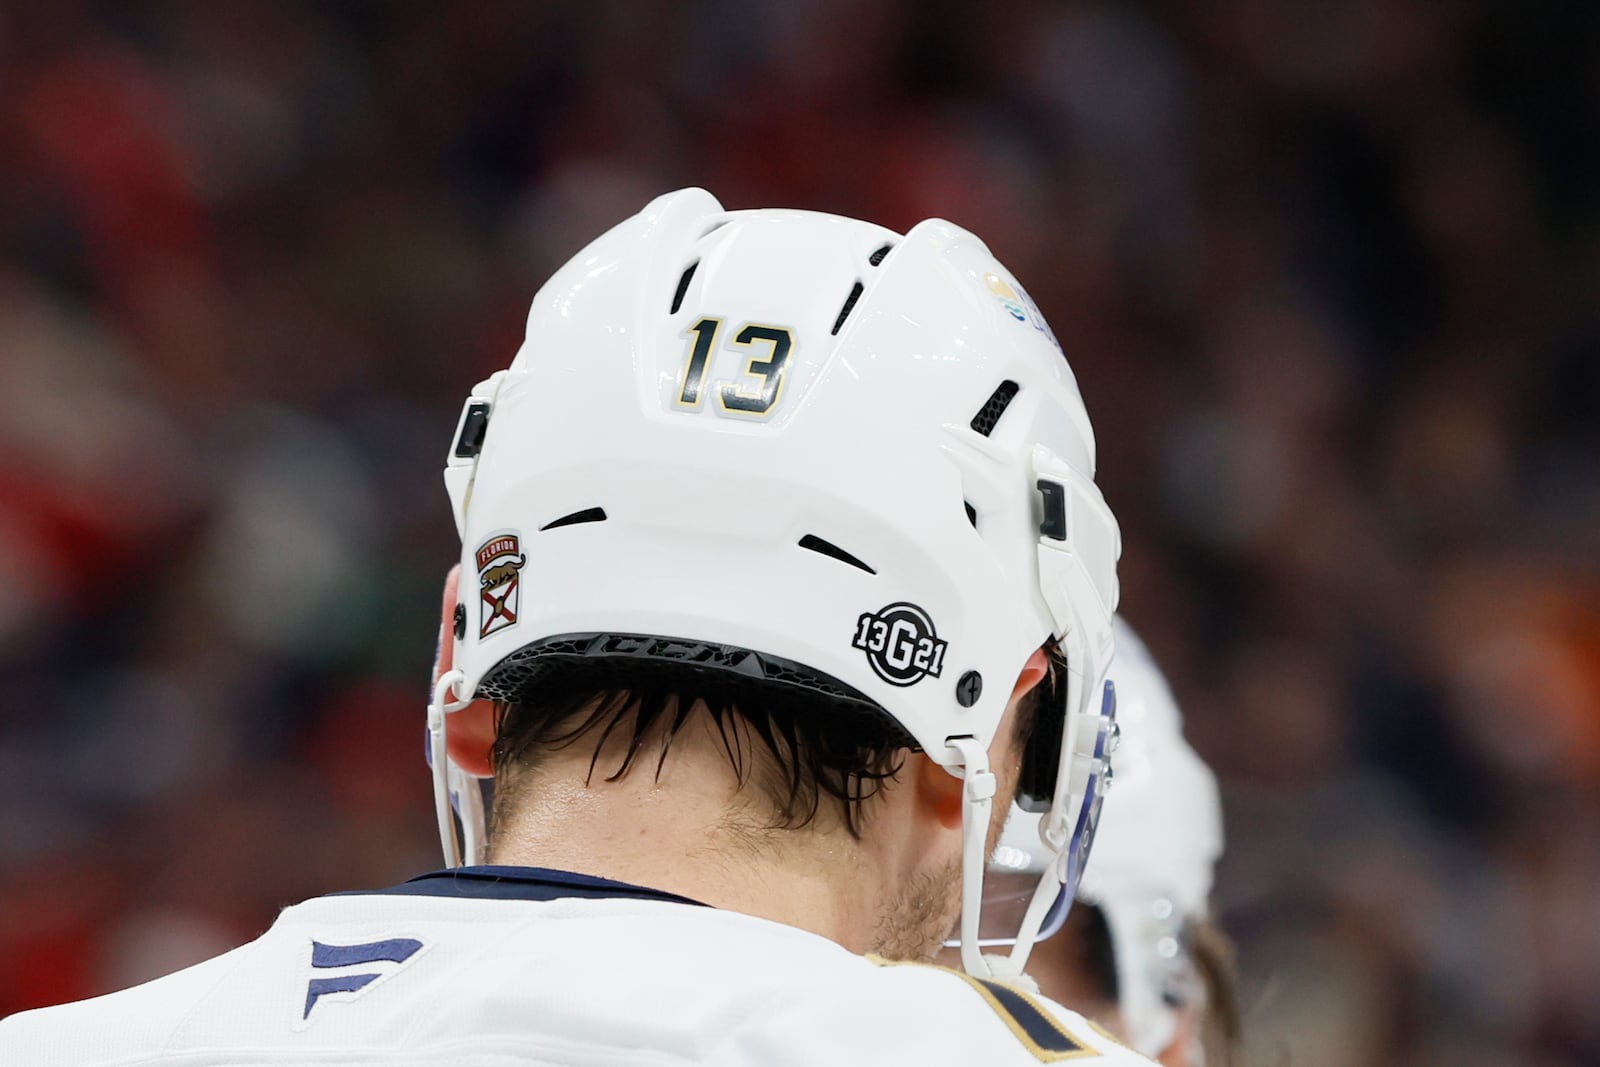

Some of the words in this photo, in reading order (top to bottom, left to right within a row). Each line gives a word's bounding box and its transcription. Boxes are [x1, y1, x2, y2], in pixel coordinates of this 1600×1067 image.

[677, 316, 796, 416] 13
[481, 540, 515, 562] FLORIDA
[601, 635, 750, 667] CCM
